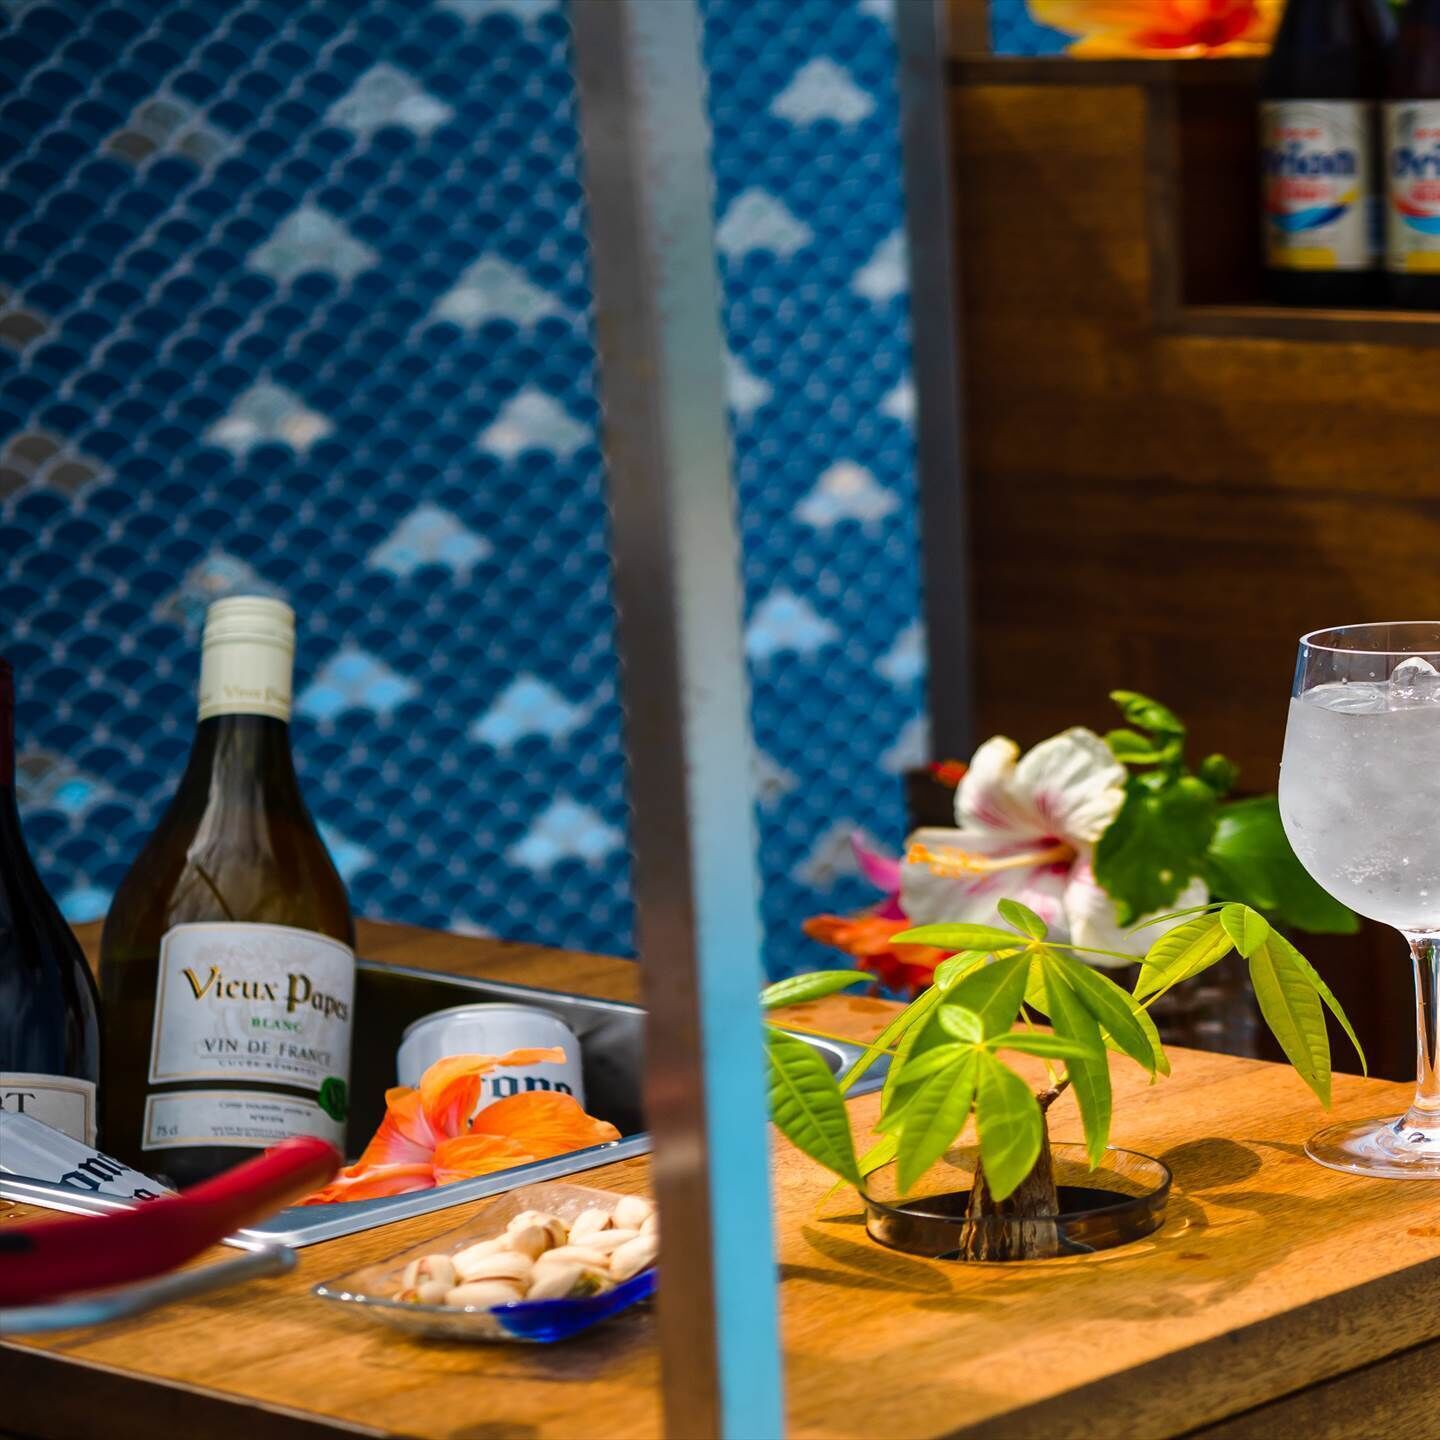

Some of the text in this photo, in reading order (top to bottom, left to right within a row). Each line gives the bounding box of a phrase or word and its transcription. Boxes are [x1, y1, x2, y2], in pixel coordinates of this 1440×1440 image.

[182, 964, 350, 1023] Vieux Papes
[250, 1017, 302, 1034] BLANC
[204, 1037, 333, 1067] VIN DE FRANCE
